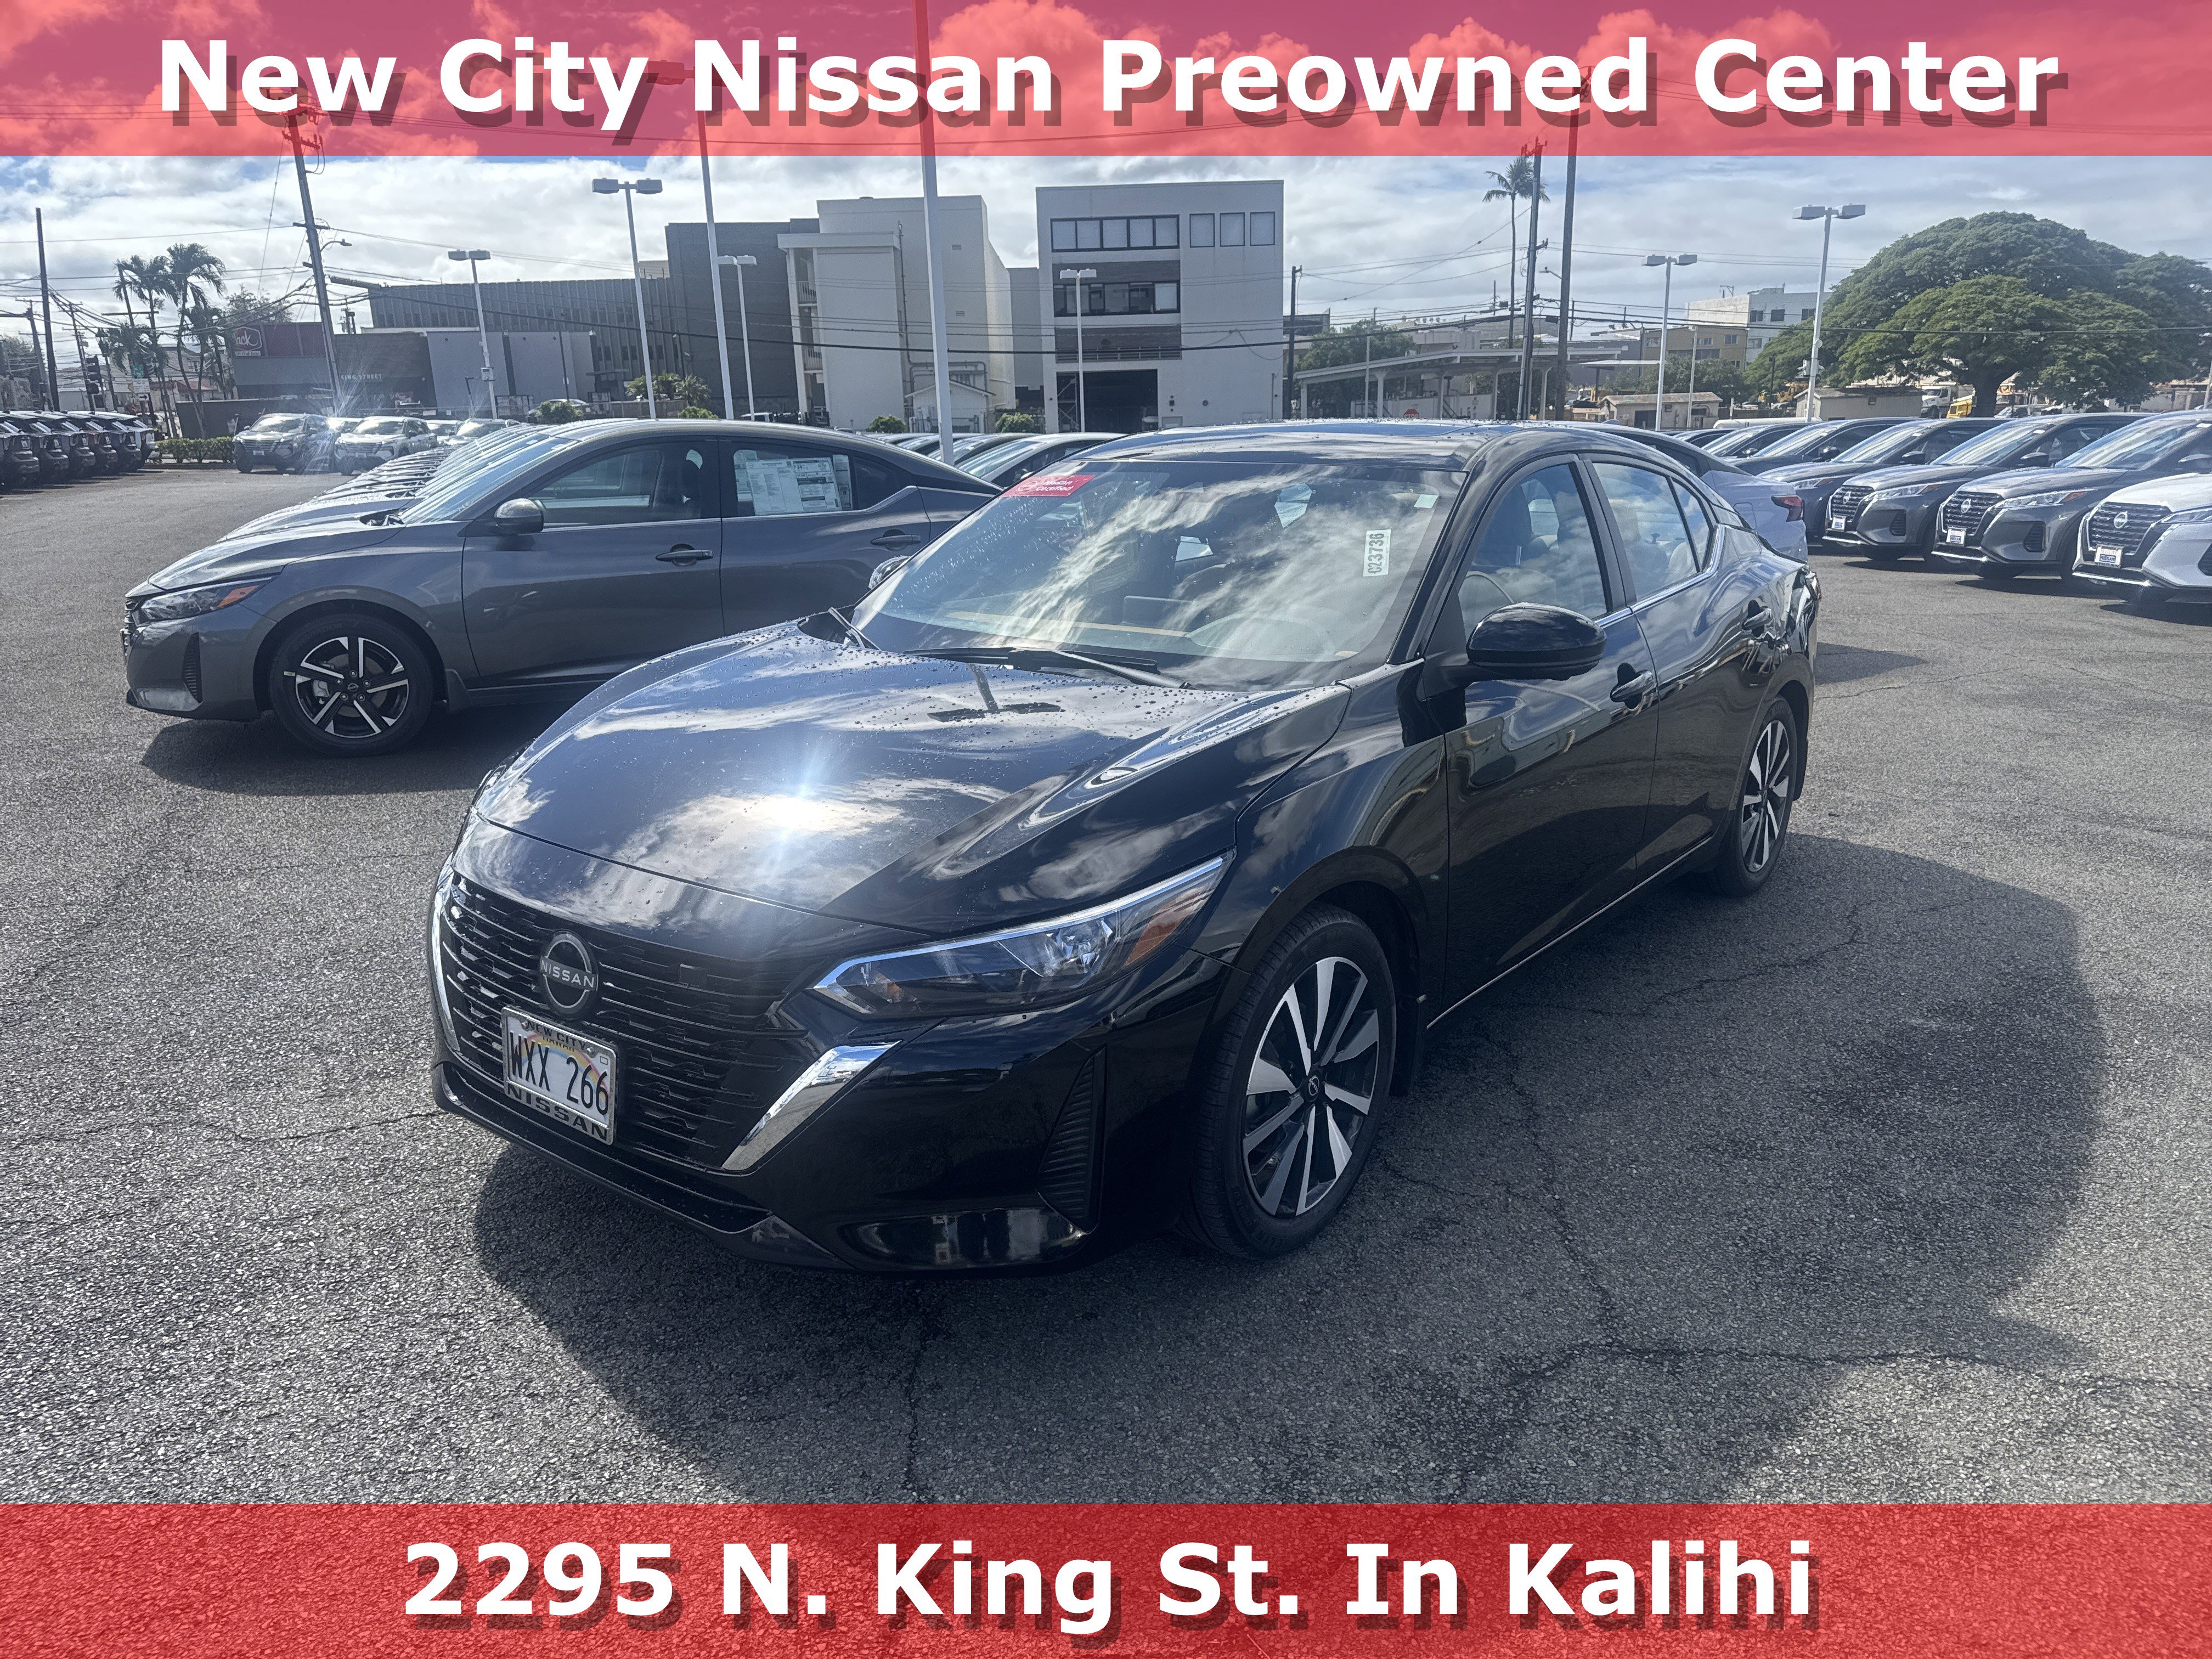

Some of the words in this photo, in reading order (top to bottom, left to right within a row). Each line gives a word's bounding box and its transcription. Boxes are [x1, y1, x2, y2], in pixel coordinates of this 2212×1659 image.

[233, 330, 259, 346] ack
[1367, 533, 1385, 574] C23736
[540, 960, 595, 988] NISSAN
[527, 1020, 552, 1036] NEW
[556, 1032, 586, 1050] CITY
[509, 1030, 551, 1092] WXX
[566, 1055, 609, 1115] 266
[507, 1082, 607, 1141] NISSAN
